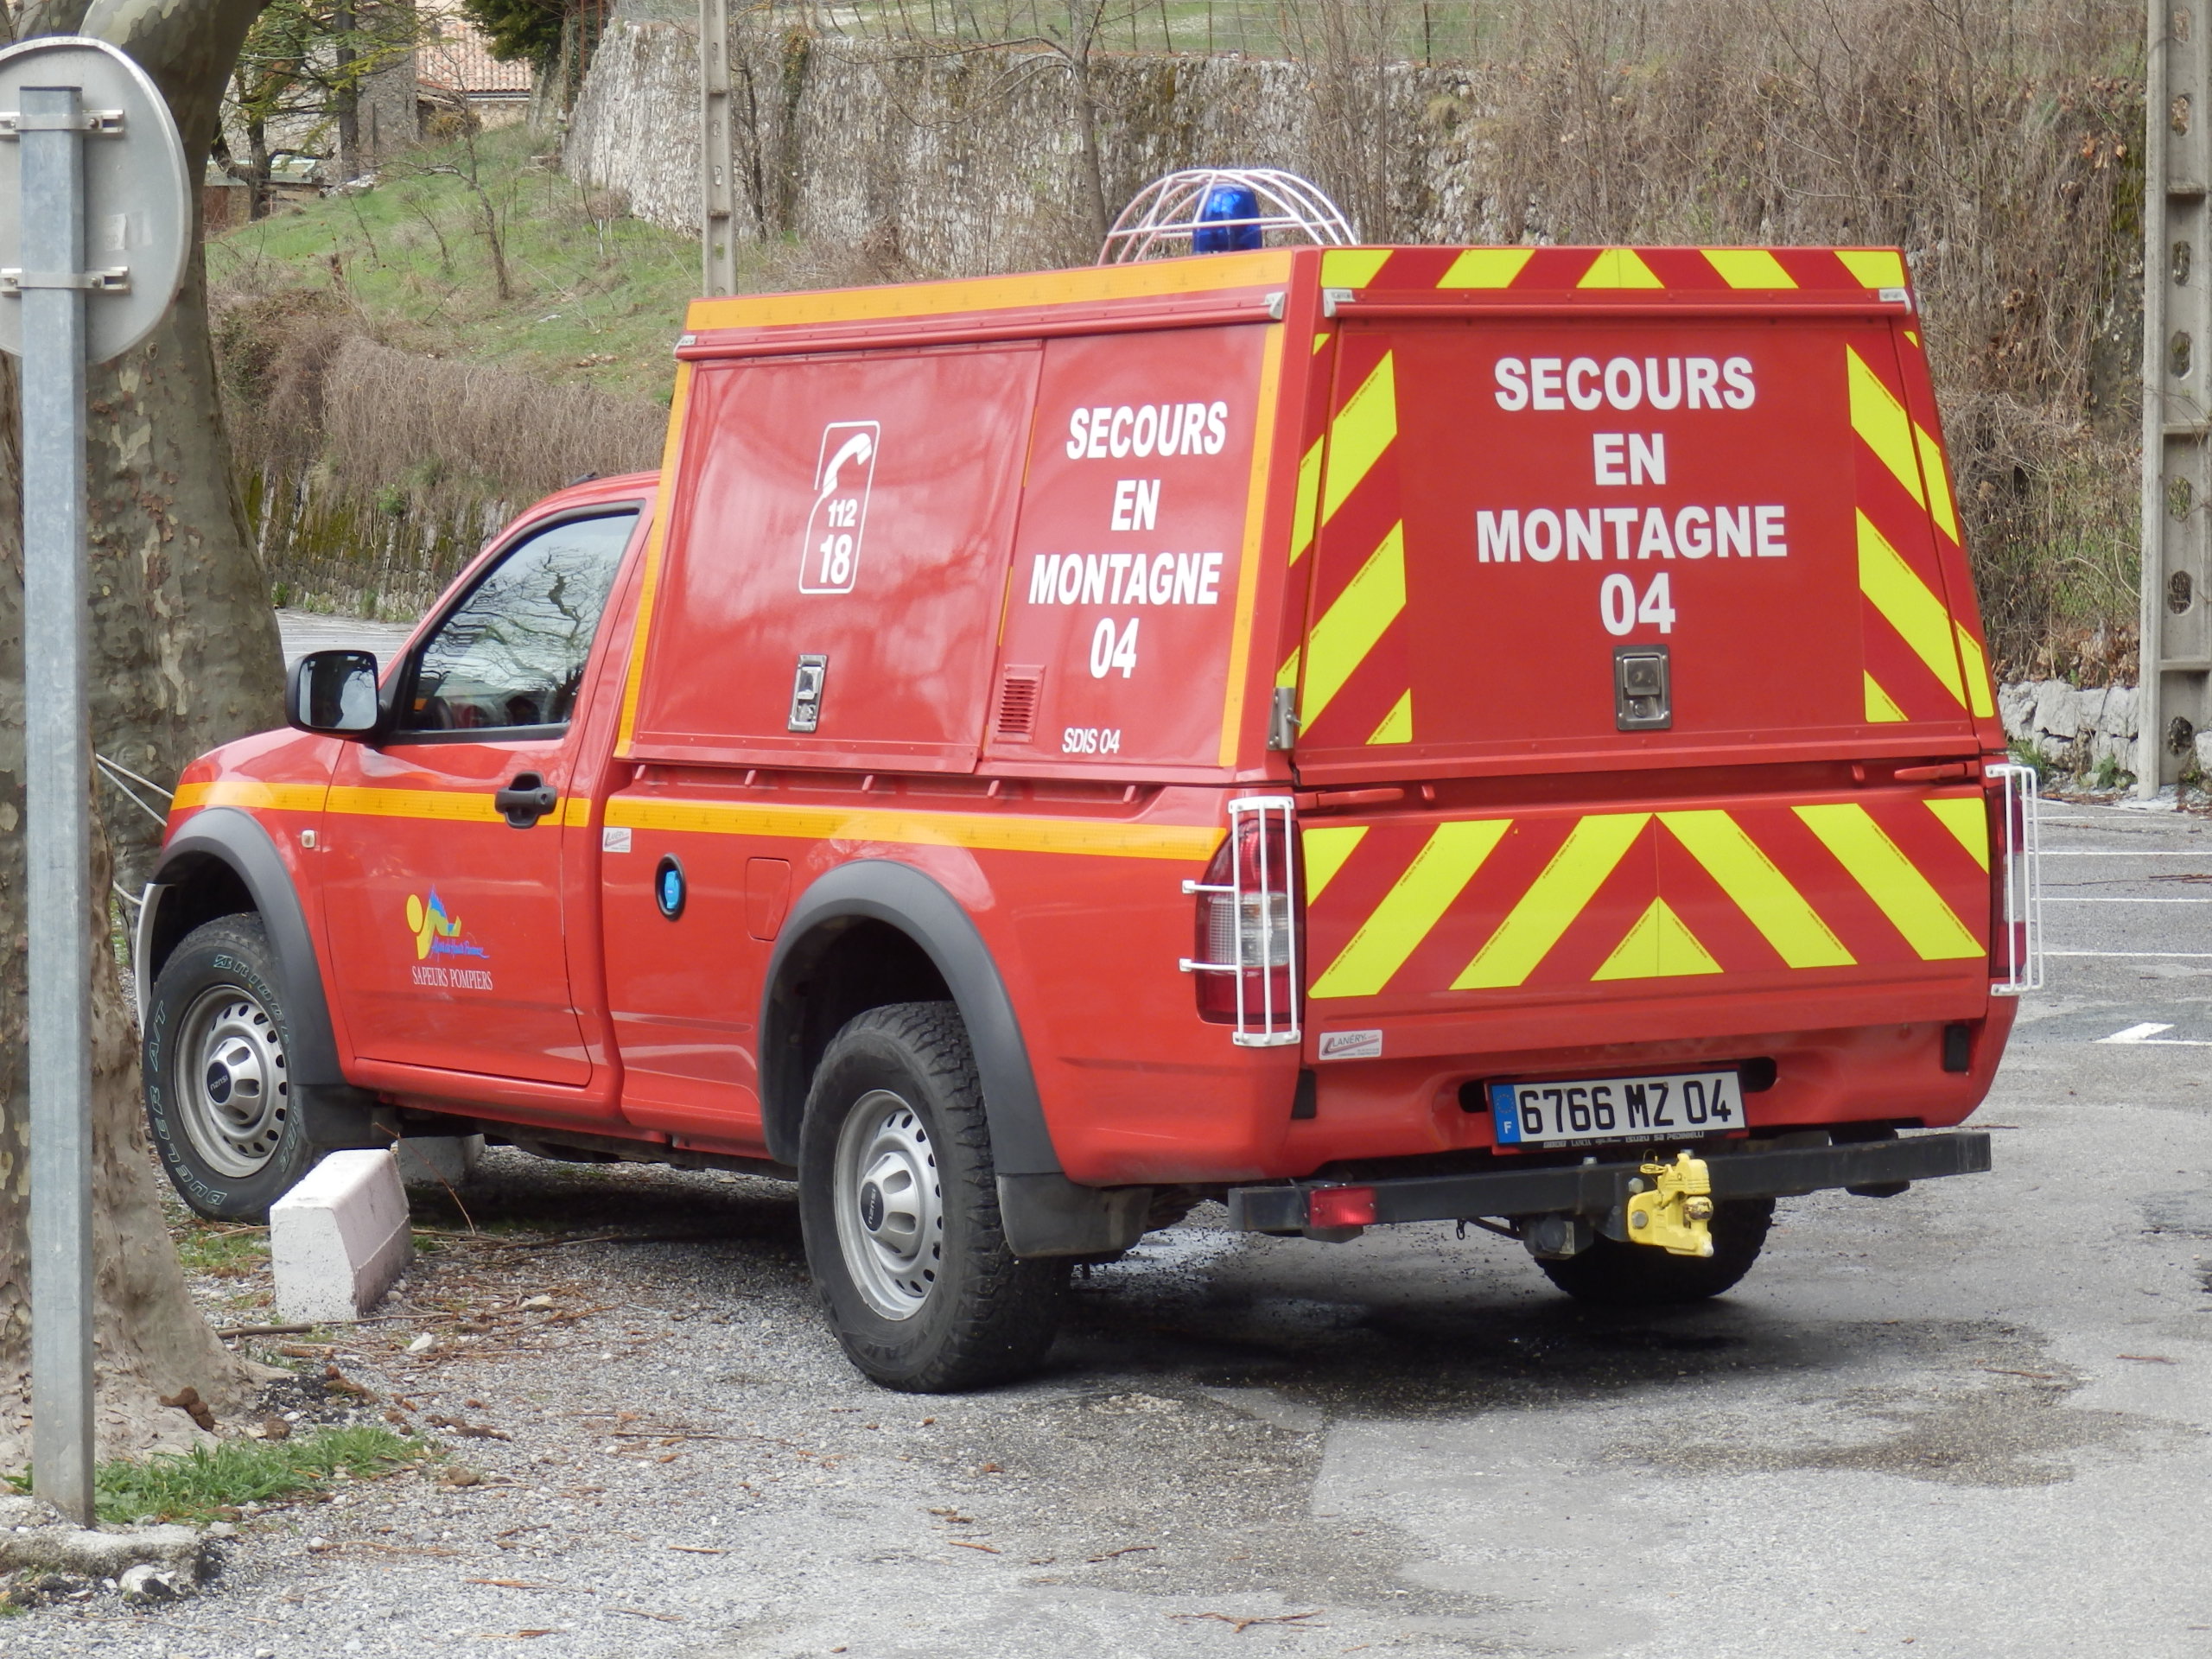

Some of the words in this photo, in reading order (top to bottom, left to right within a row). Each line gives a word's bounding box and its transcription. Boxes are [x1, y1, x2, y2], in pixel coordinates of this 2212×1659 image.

[1494, 355, 1757, 412] SECOURS
[1065, 400, 1229, 461] SECOURS
[1592, 432, 1668, 486] EN
[827, 499, 858, 528] 112
[1109, 479, 1160, 531] EN
[819, 534, 851, 584] 18
[1475, 504, 1789, 564] MONTAGNE
[1027, 551, 1224, 607] MONTAGNE
[1599, 571, 1677, 636] 04
[1090, 617, 1140, 680] 04
[1061, 727, 1096, 754] SDIS
[1098, 728, 1121, 754] 04
[411, 965, 448, 987] SAPEURS
[449, 969, 493, 991] POMPIERS
[149, 999, 167, 1072] A/T
[209, 1074, 229, 1091] ISUZU
[1519, 1085, 1616, 1135] 6766
[1624, 1082, 1675, 1128] MZ
[1682, 1078, 1732, 1125] 04
[149, 1084, 228, 1206] DUELER
[1503, 1121, 1512, 1135] F
